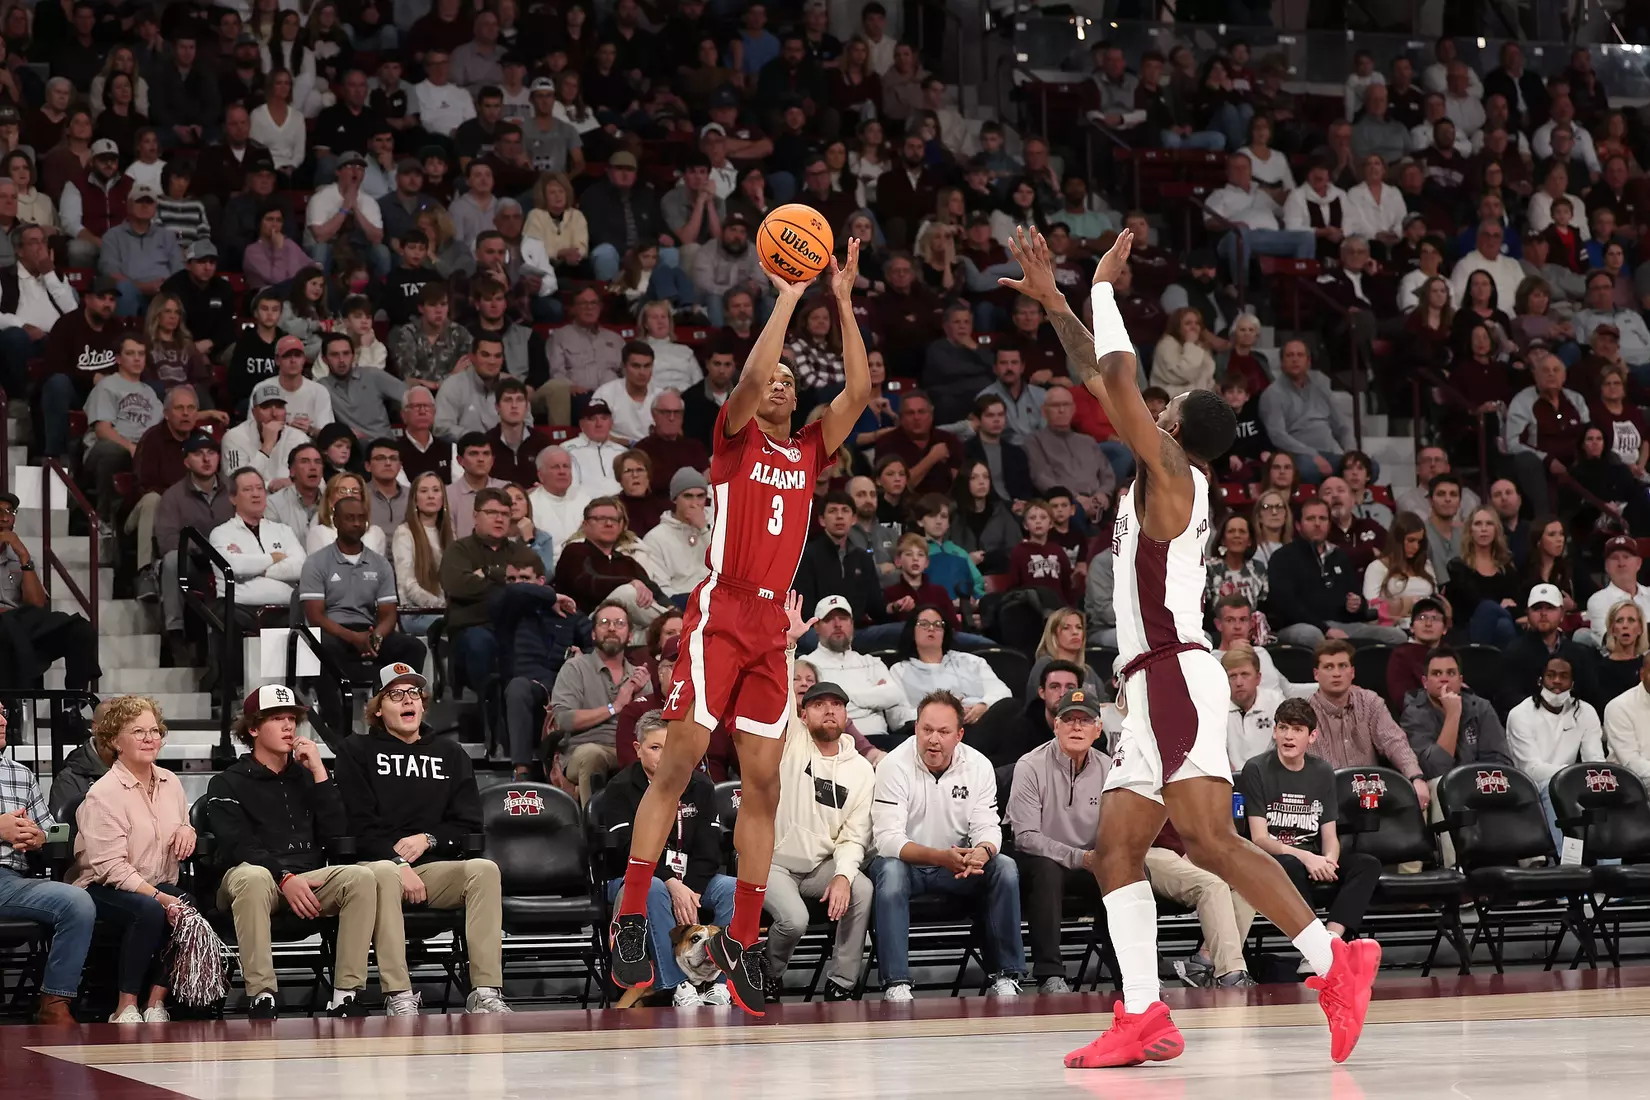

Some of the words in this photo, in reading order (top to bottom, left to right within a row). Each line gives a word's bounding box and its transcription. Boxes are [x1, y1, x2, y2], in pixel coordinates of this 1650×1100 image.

[780, 226, 822, 265] Wilson
[770, 252, 804, 278] NCAA
[247, 357, 276, 374] STA
[749, 461, 806, 490] ALAAMA
[767, 494, 784, 536] 3
[663, 680, 685, 711] A
[1266, 811, 1319, 832] CHAMPIONS
[288, 841, 311, 850] AIR
